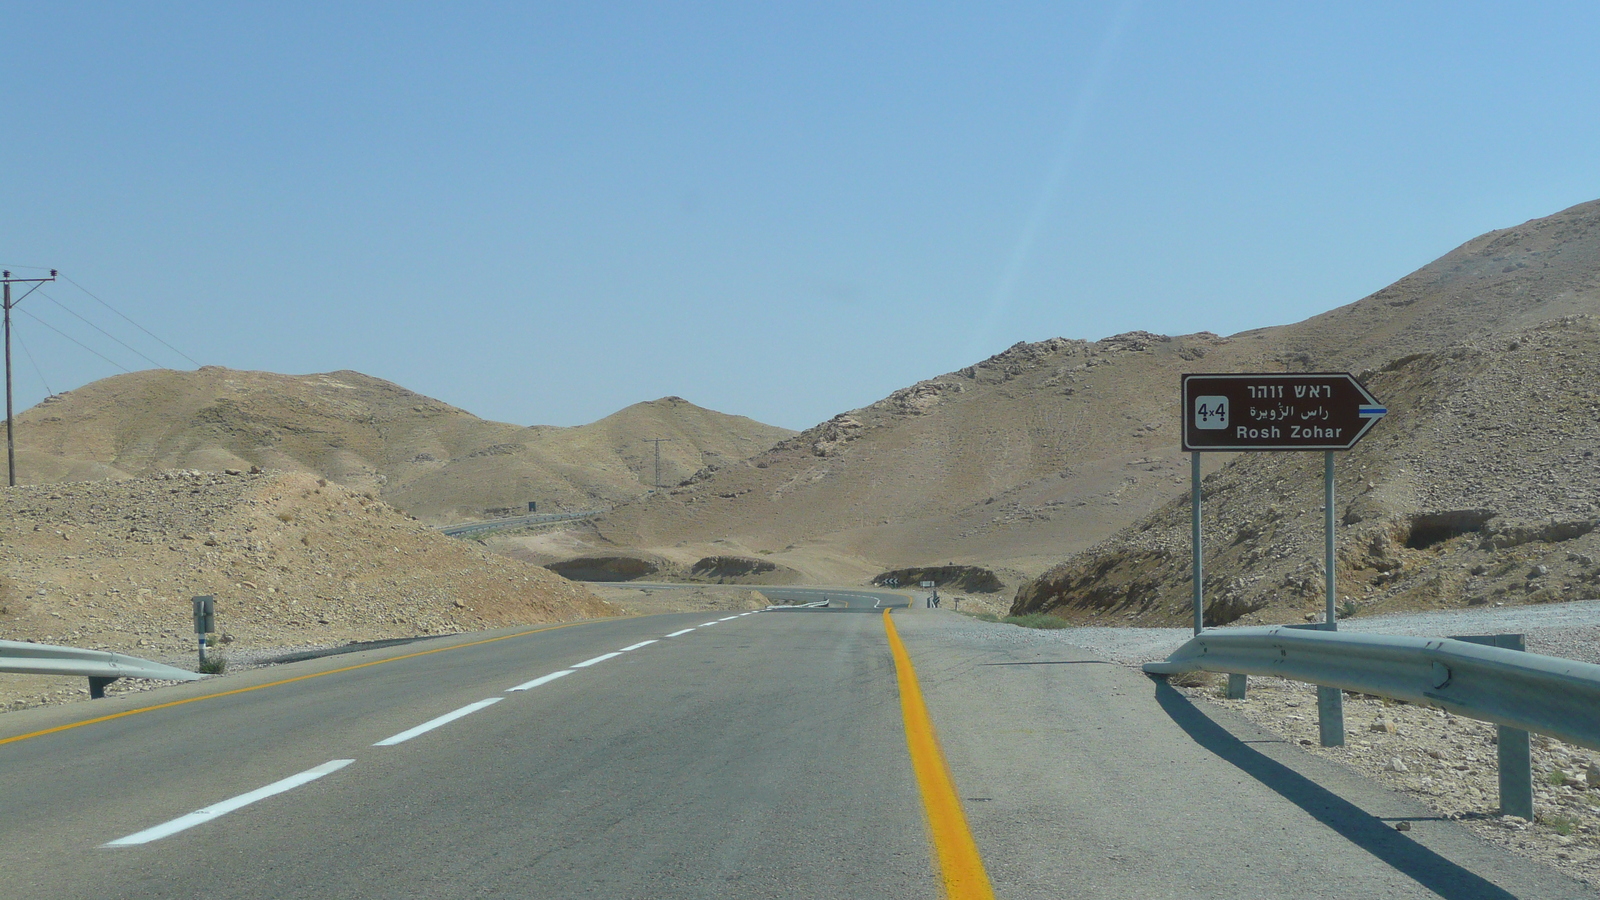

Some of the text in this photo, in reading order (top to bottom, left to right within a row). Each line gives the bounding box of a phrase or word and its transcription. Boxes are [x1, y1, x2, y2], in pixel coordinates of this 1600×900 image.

[1247, 385, 1331, 398] ראש זוהר
[1236, 425, 1343, 439] Rosh Zohar
